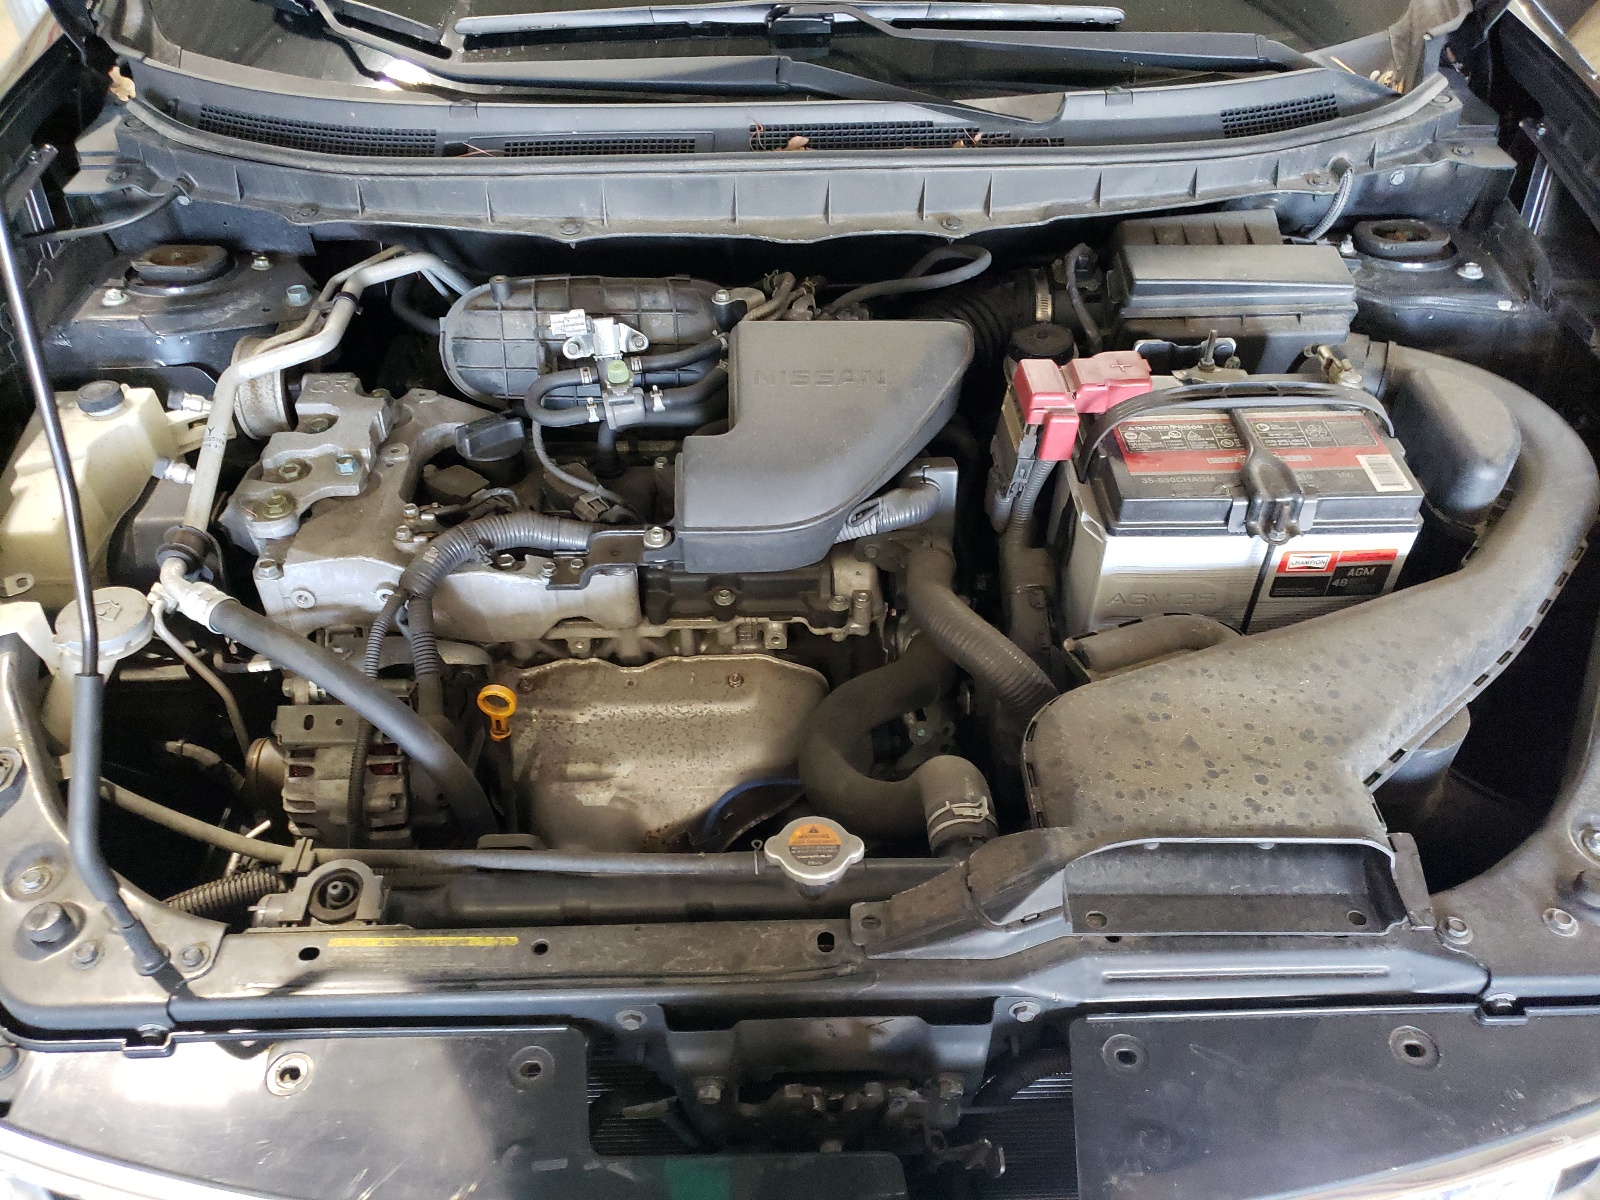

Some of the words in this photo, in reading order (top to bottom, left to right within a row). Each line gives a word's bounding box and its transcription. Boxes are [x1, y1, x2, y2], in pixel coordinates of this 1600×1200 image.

[753, 369, 887, 387] NISSAN
[1290, 558, 1327, 566] CHAMPION
[1347, 566, 1377, 577] AGM
